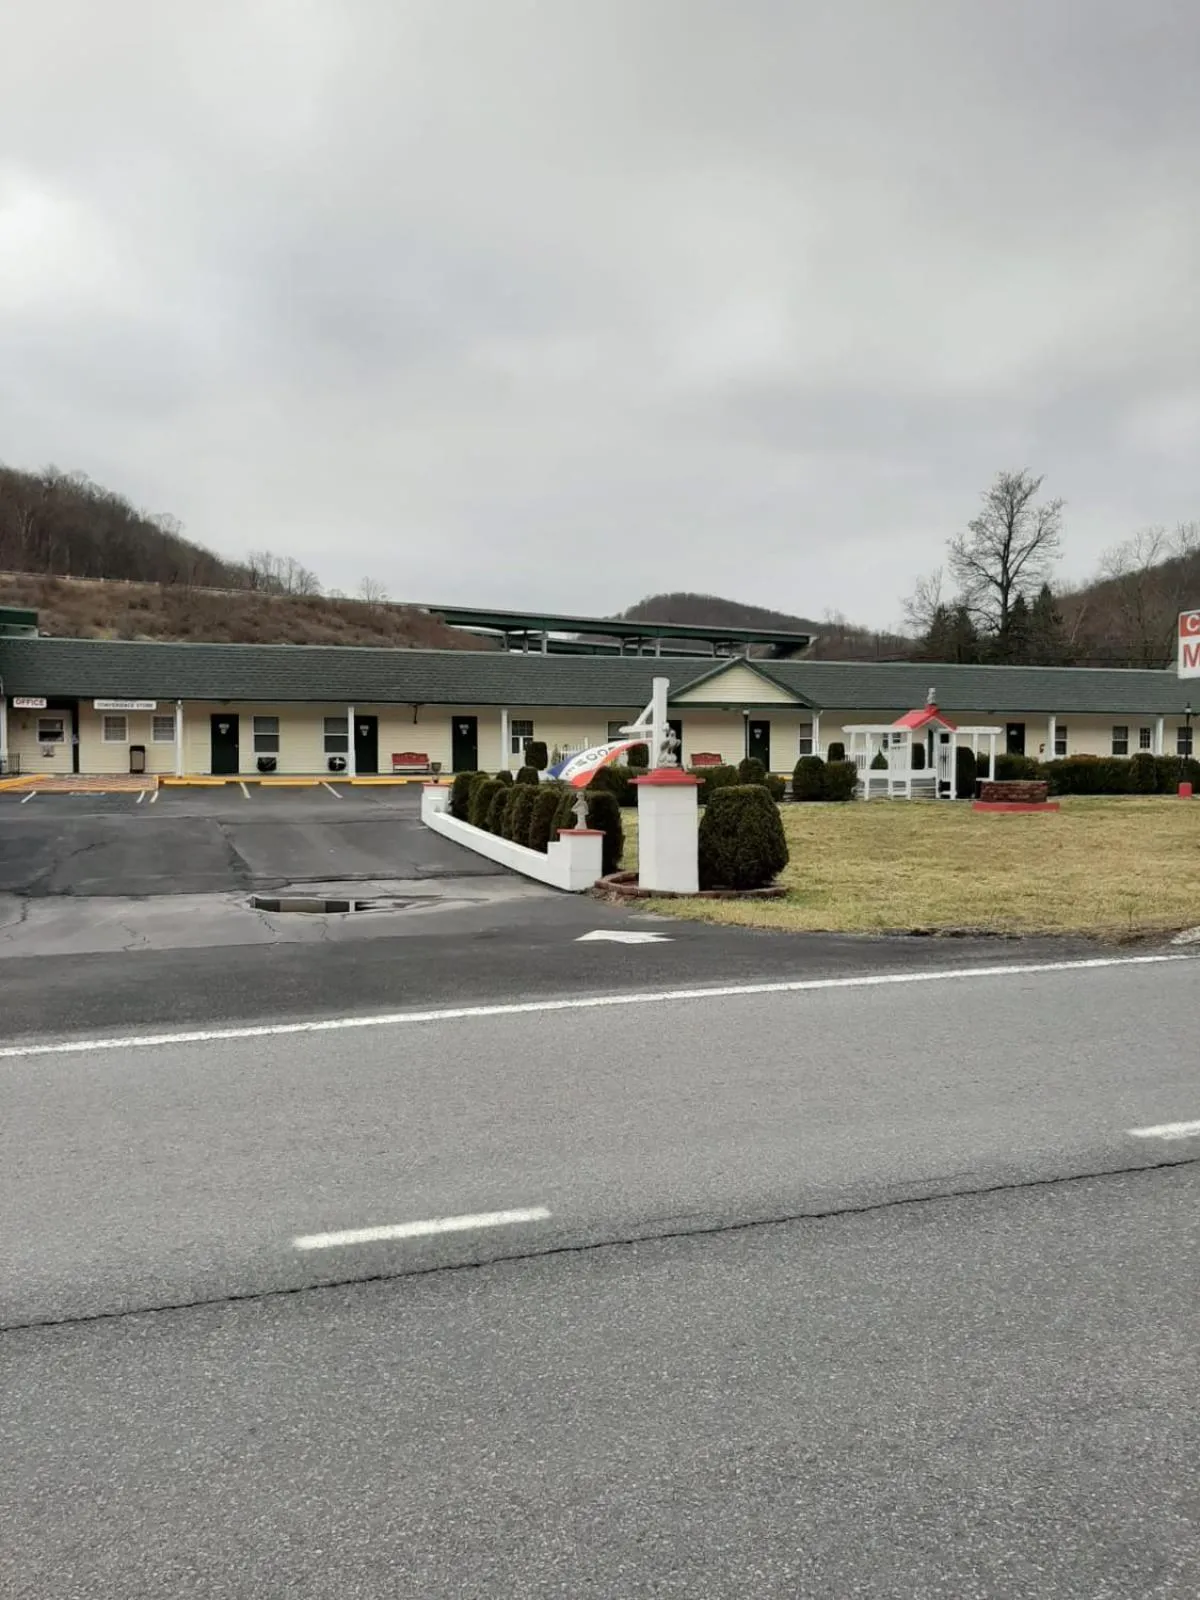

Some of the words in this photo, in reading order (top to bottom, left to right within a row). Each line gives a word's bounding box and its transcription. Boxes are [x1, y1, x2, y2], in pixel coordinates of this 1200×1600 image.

[1186, 614, 1200, 632] C
[1183, 642, 1200, 669] M
[15, 698, 45, 707] OFFICE
